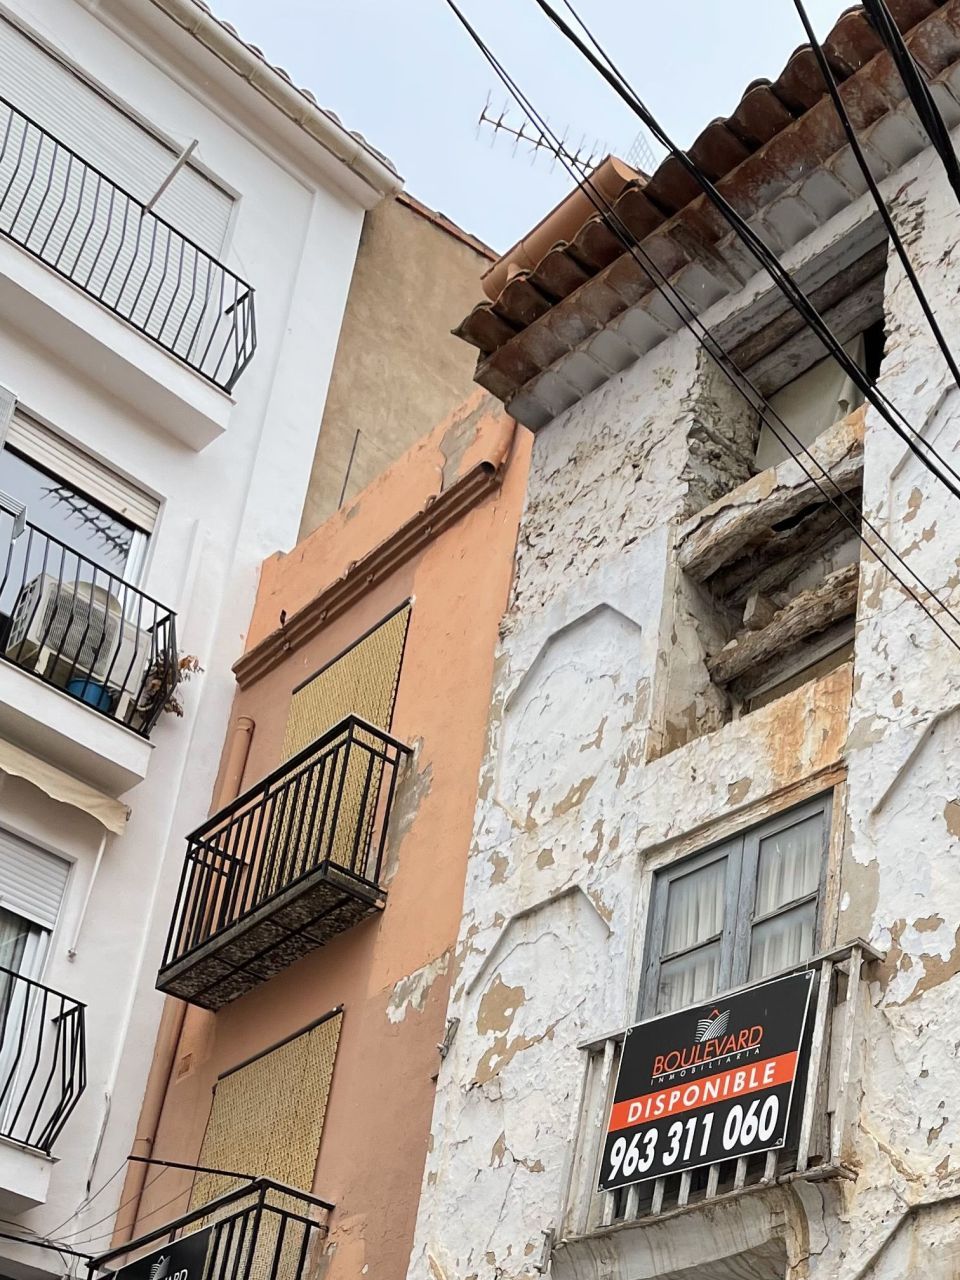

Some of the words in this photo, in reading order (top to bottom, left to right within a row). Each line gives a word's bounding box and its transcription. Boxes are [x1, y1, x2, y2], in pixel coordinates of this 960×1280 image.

[651, 1048, 760, 1086] INMOBILIARIA
[653, 1025, 763, 1076] BOULEVARD
[627, 1062, 776, 1123] DISPONIBLE
[608, 1128, 658, 1181] 963
[663, 1112, 714, 1166] 311
[723, 1095, 779, 1150] 060
